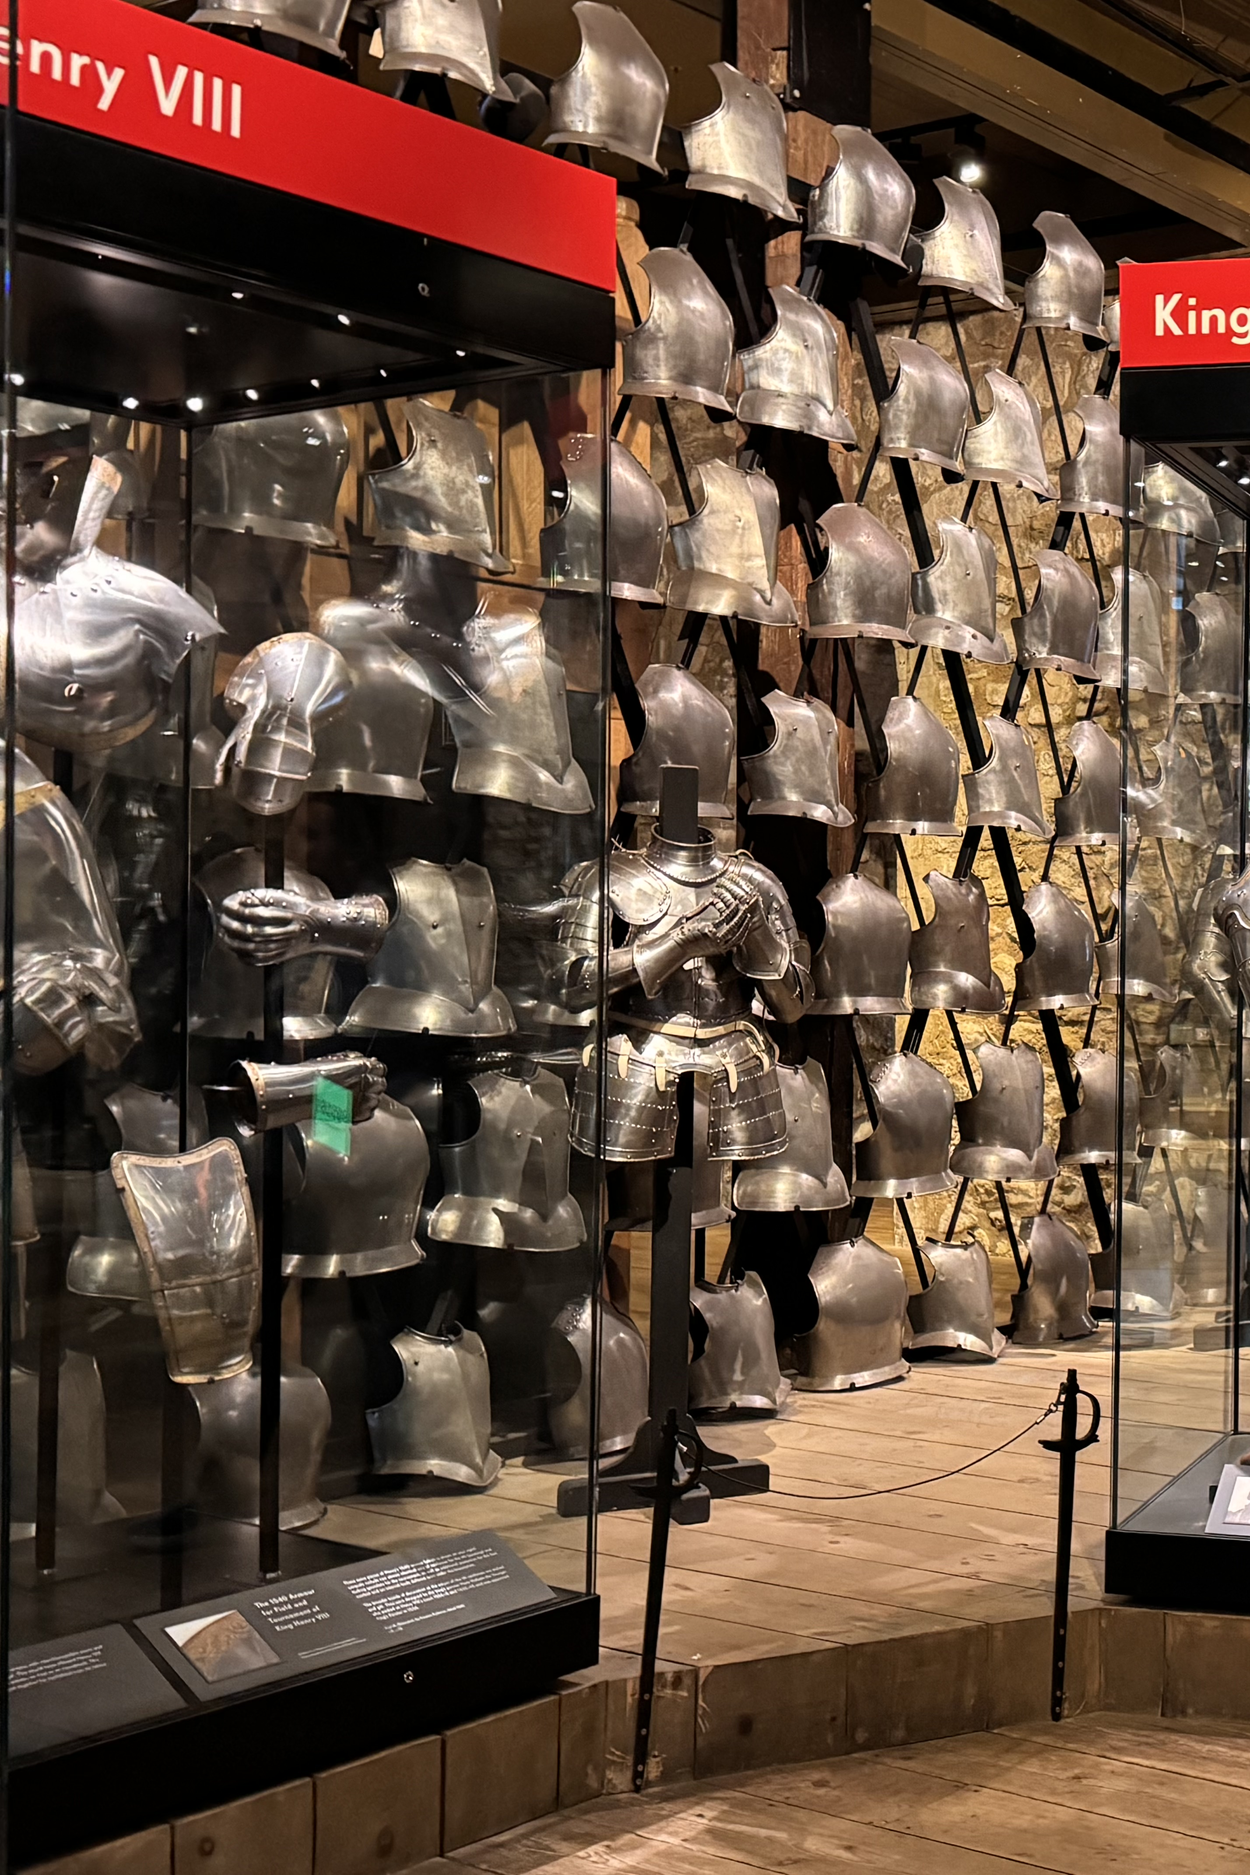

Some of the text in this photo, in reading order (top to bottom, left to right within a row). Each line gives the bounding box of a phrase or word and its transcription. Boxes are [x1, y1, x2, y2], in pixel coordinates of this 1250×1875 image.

[148, 53, 242, 139] VIII
[254, 1601, 269, 1609] The
[273, 1603, 293, 1612] Field
[293, 1599, 308, 1608] and
[268, 1609, 311, 1623] Tournament
[275, 1612, 330, 1631] King Henry VIII
